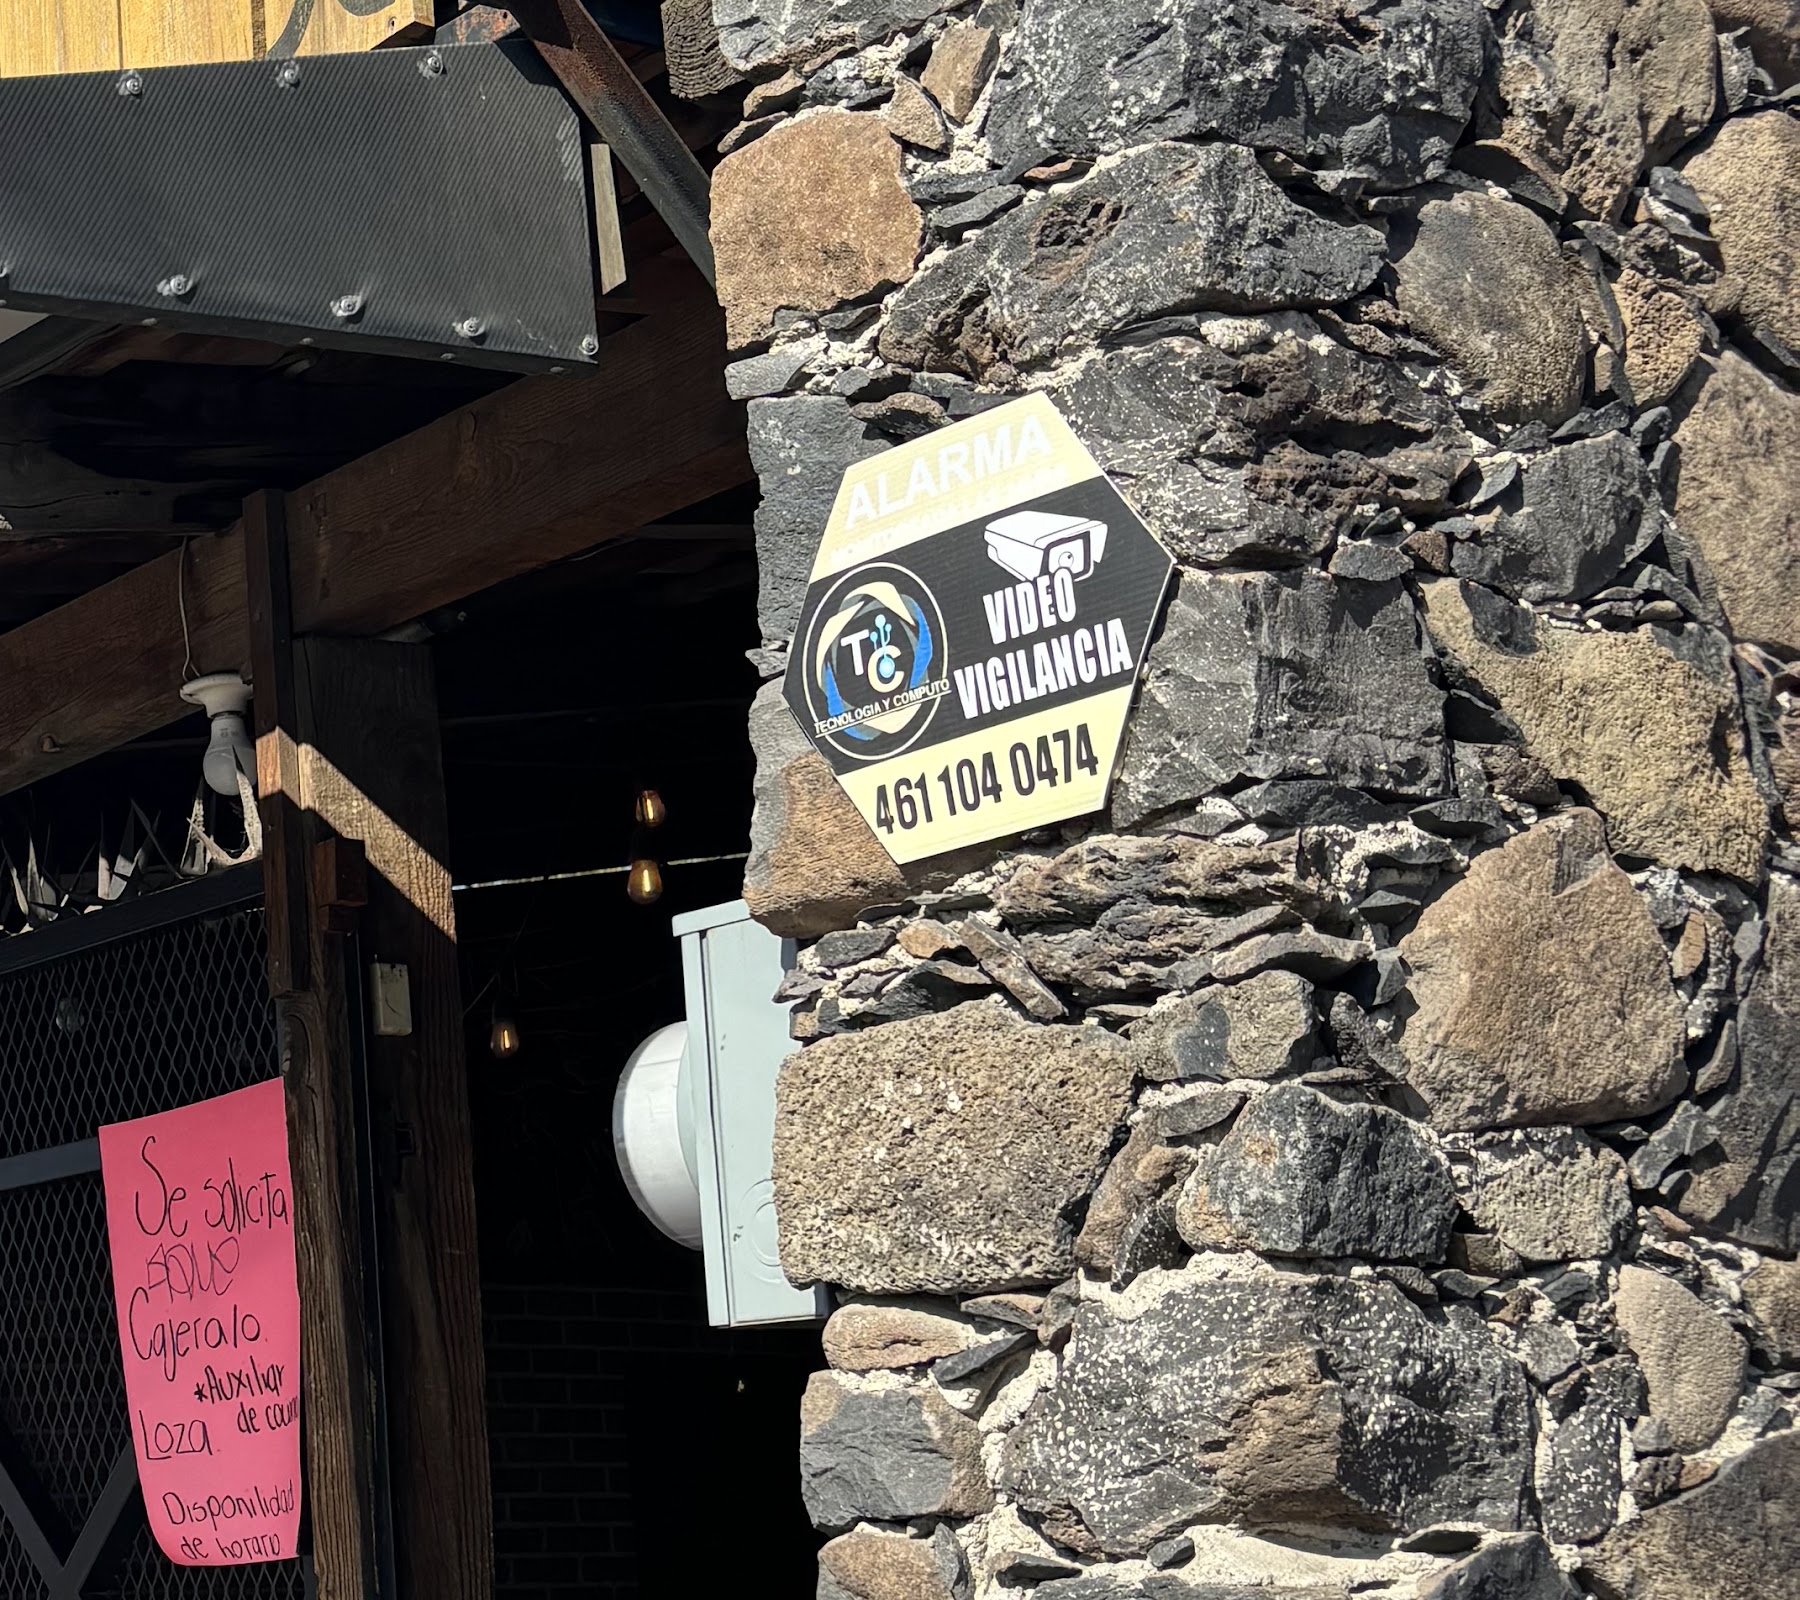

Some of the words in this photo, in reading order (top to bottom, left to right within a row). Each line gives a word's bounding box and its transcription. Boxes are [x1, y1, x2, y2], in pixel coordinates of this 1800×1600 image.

[845, 414, 1051, 530] ALARMA
[982, 568, 1076, 645] VIDEO
[953, 617, 1133, 720] VIGILANCIA
[814, 703, 881, 734] TECNOLOGIA
[882, 697, 891, 710] Y
[875, 772, 932, 835] 461
[936, 749, 1003, 817] 104
[1008, 722, 1099, 800] 0474
[135, 1136, 188, 1237] Se
[204, 1157, 288, 1234] solicita
[237, 1401, 260, 1434] de
[180, 1536, 209, 1560] de
